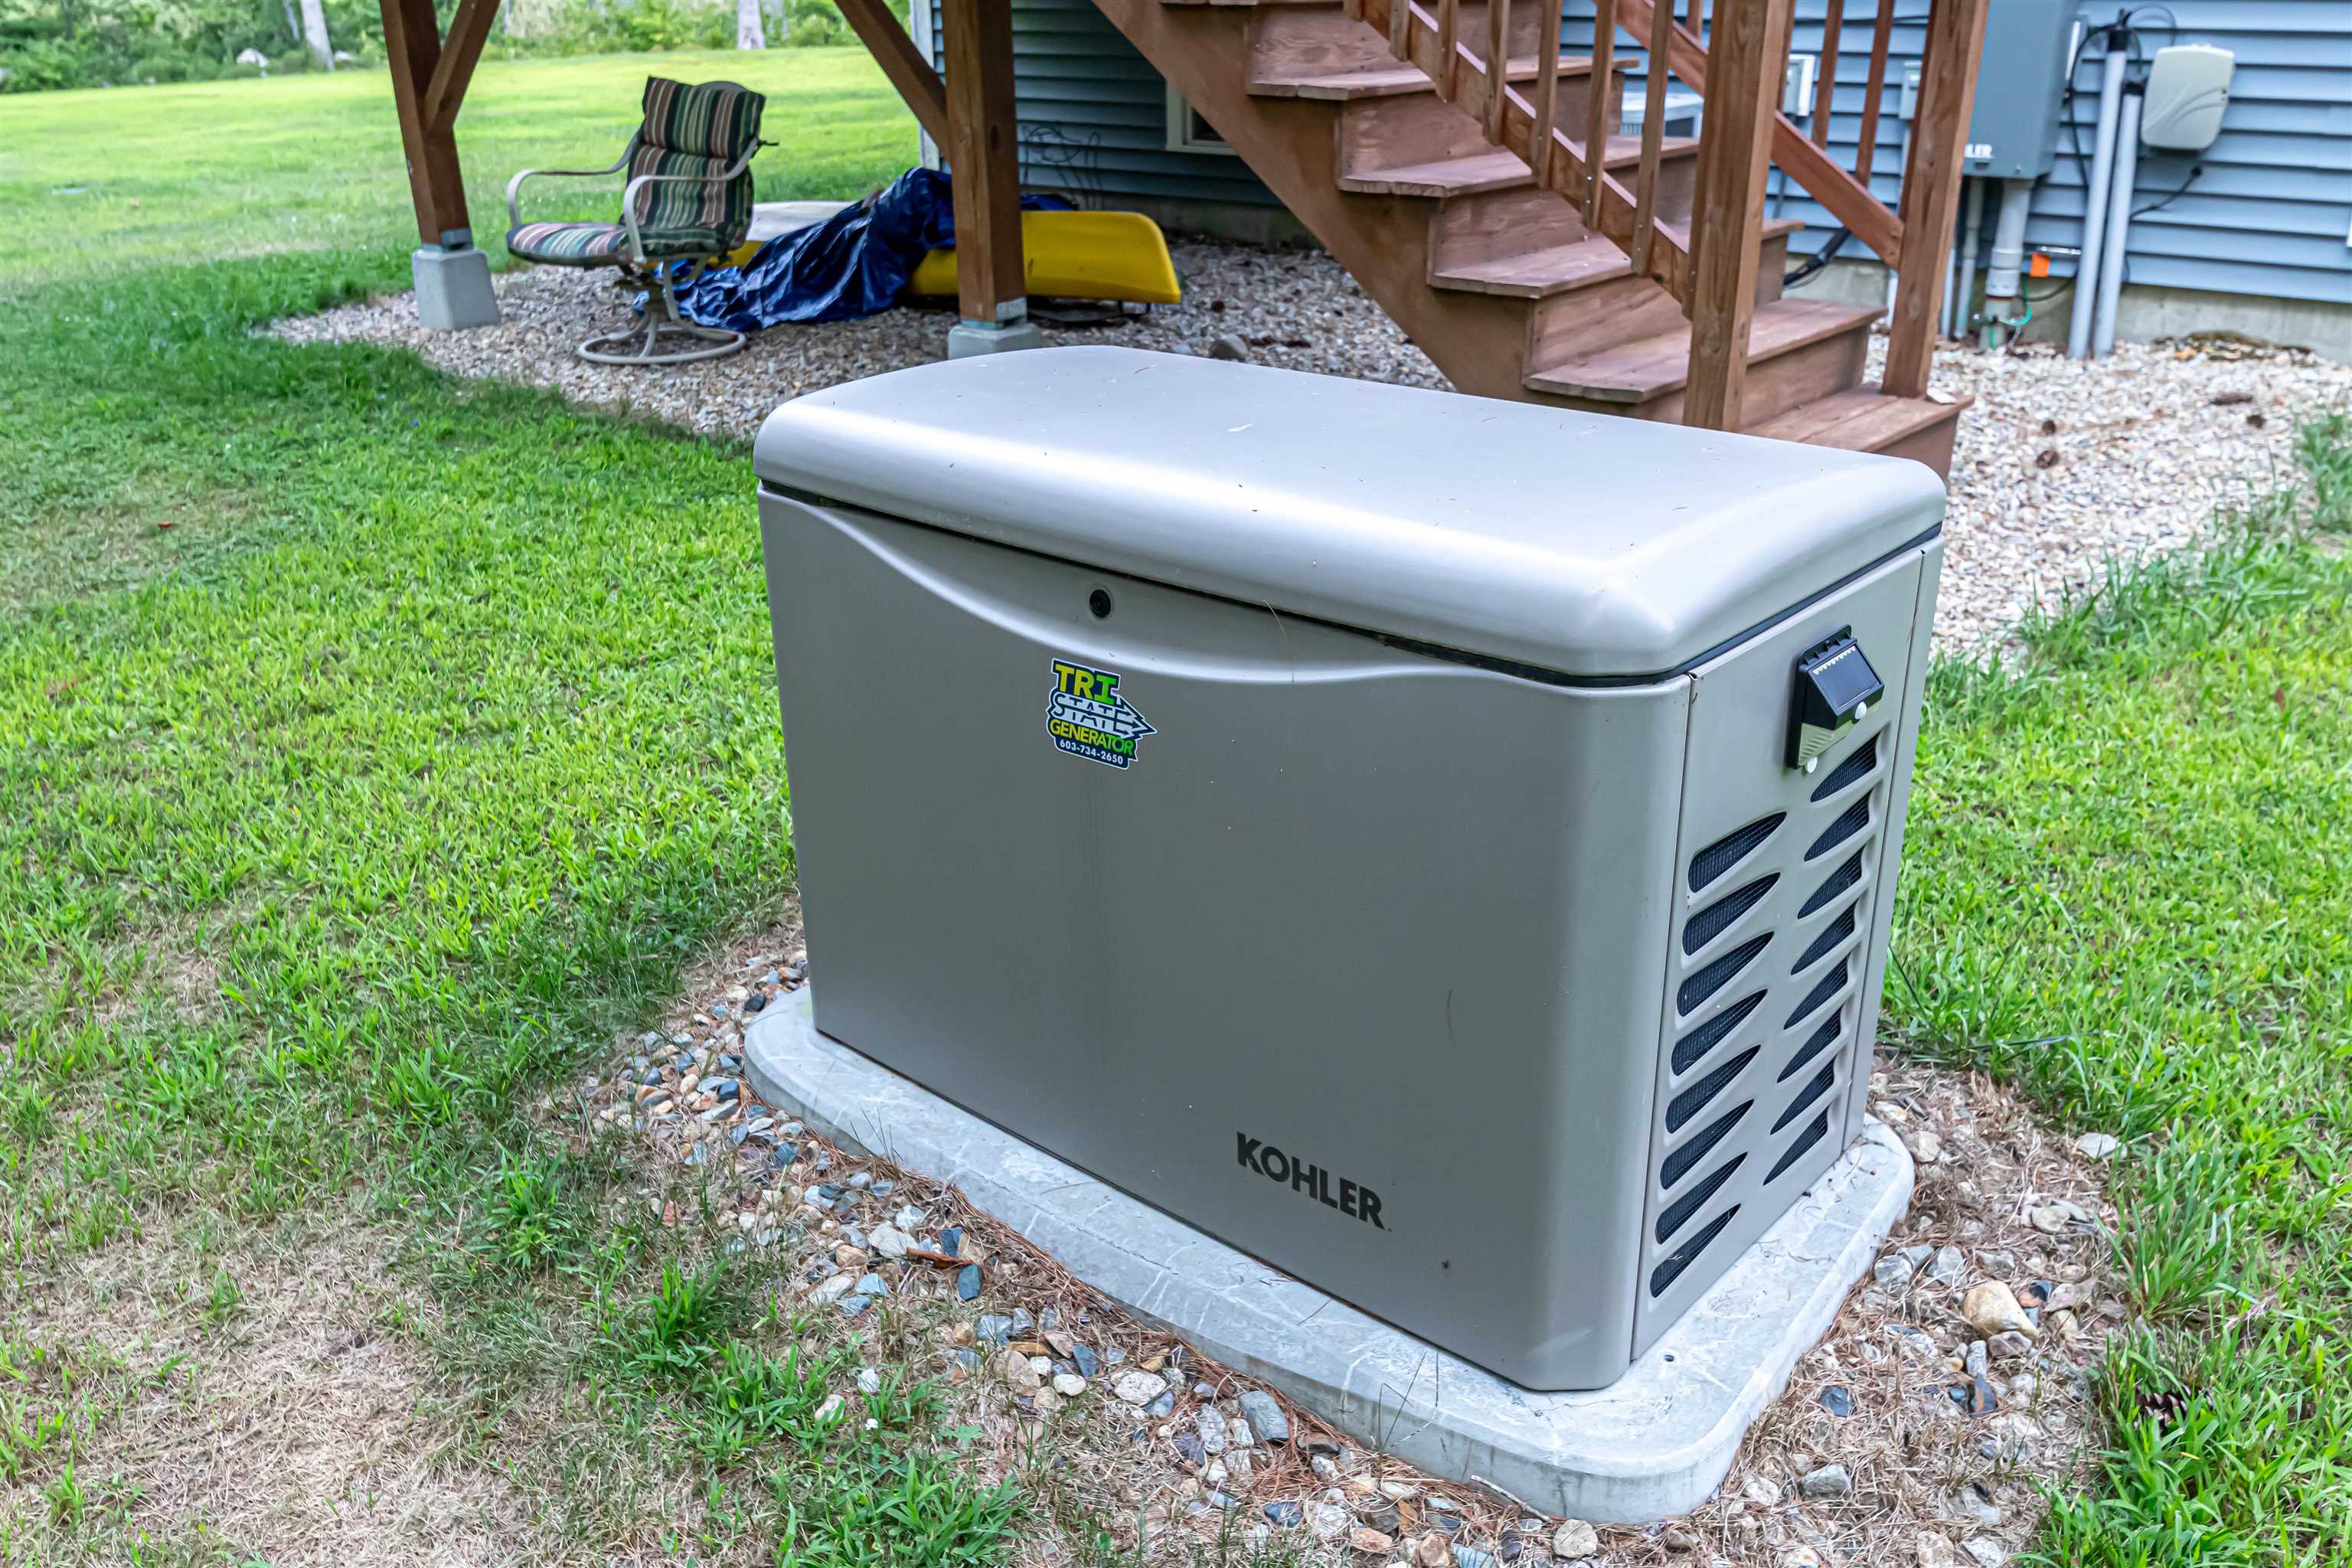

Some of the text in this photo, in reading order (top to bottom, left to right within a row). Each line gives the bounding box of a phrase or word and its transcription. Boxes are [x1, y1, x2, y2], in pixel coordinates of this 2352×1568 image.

[1055, 664, 1116, 705] TRI
[1051, 691, 1141, 736] STATE
[1050, 718, 1135, 756] GENERATOR
[1060, 739, 1123, 765] 603-734-2650
[1236, 1132, 1386, 1230] KOHLER
